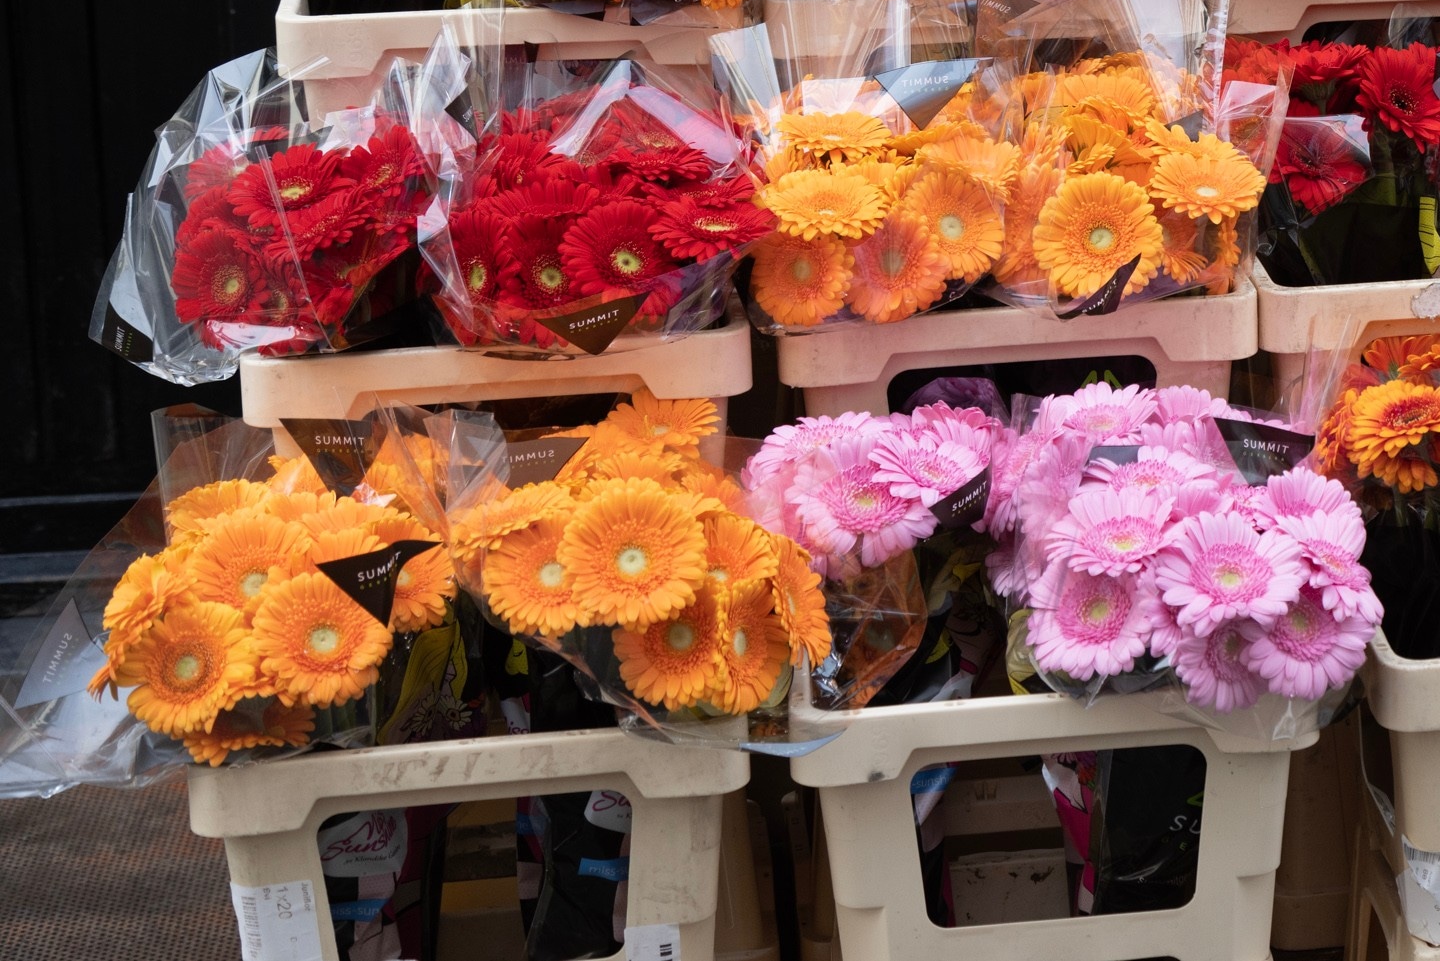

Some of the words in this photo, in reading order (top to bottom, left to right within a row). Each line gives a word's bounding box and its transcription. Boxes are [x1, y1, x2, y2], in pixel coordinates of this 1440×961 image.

[569, 309, 619, 330] SUMMIT
[114, 326, 126, 352] SUMMIT
[315, 435, 364, 446] SUMMIT
[1243, 438, 1290, 454] SUMMIT
[952, 481, 987, 512] SUMMIT
[357, 551, 402, 583] SUMMIT
